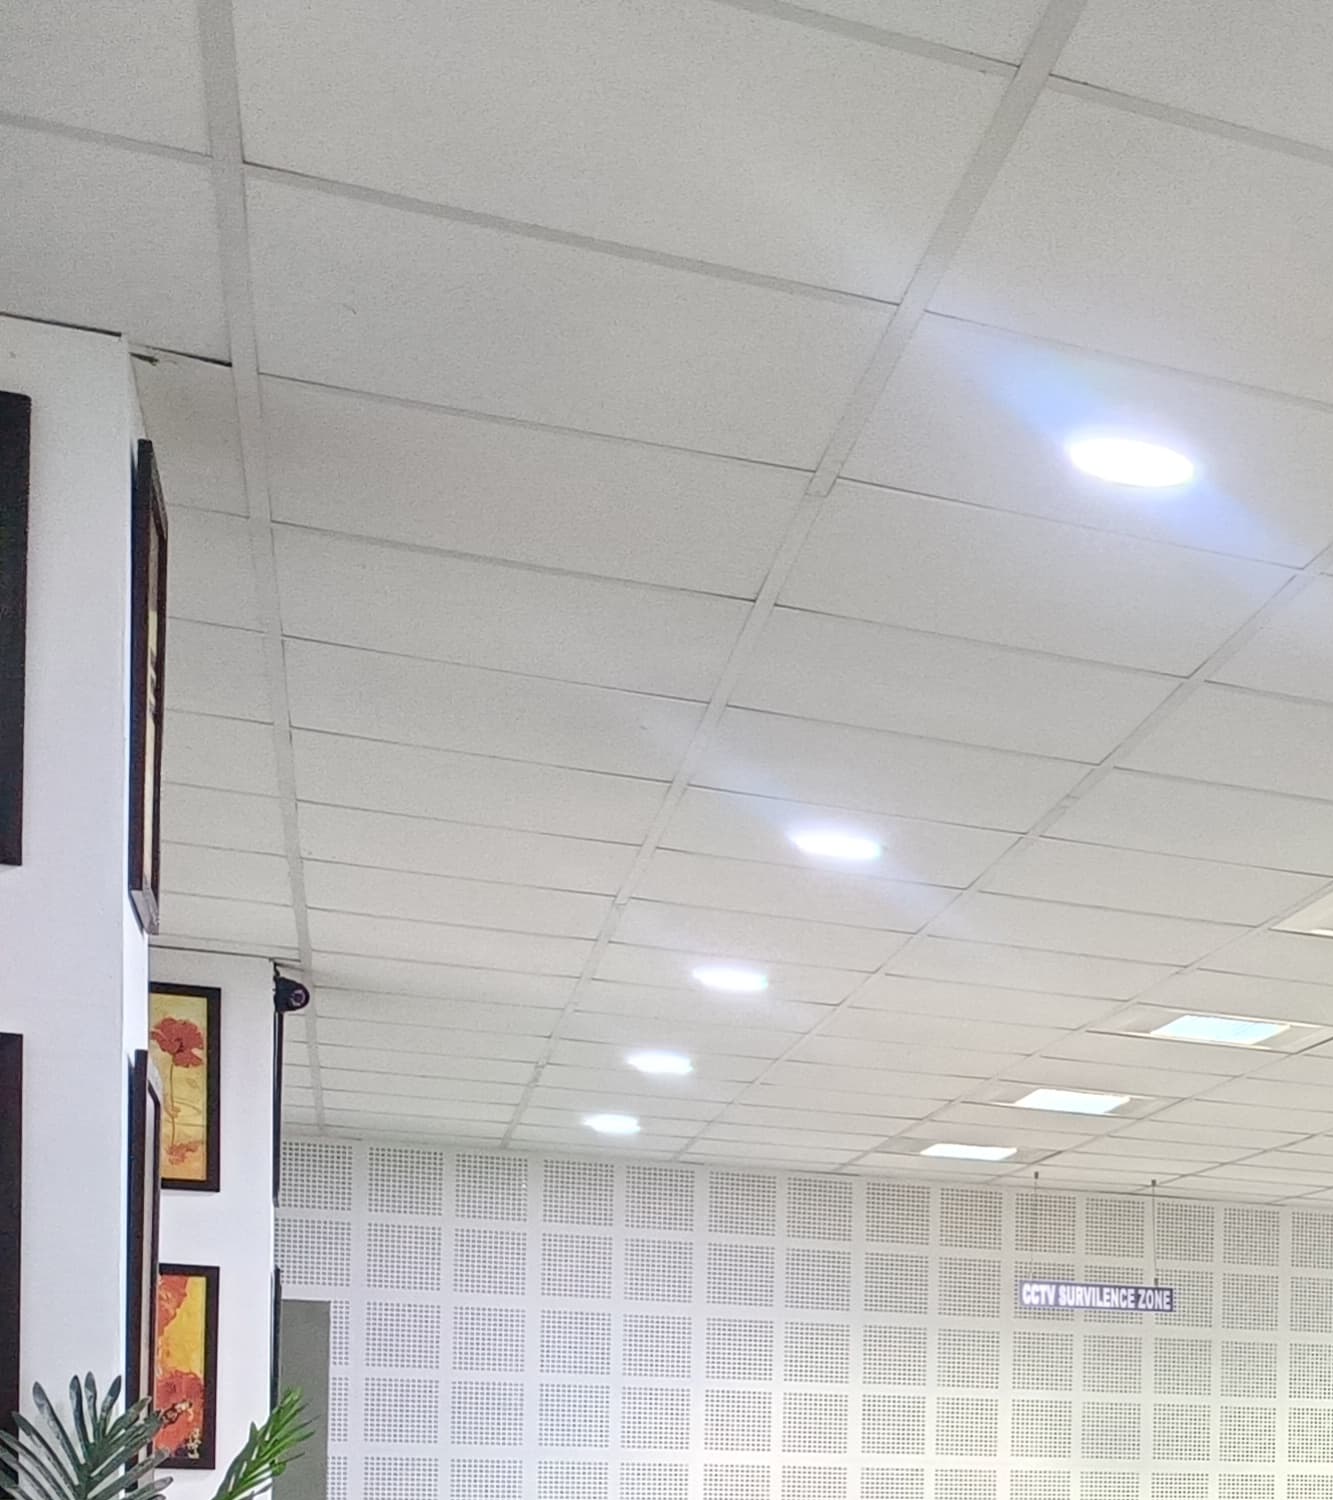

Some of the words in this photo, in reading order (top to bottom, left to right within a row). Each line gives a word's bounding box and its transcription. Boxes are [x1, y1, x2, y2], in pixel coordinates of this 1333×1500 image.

[1022, 1283, 1057, 1306] CCTV
[1058, 1284, 1135, 1309] SURVILENCE
[1137, 1289, 1171, 1310] ZONE
